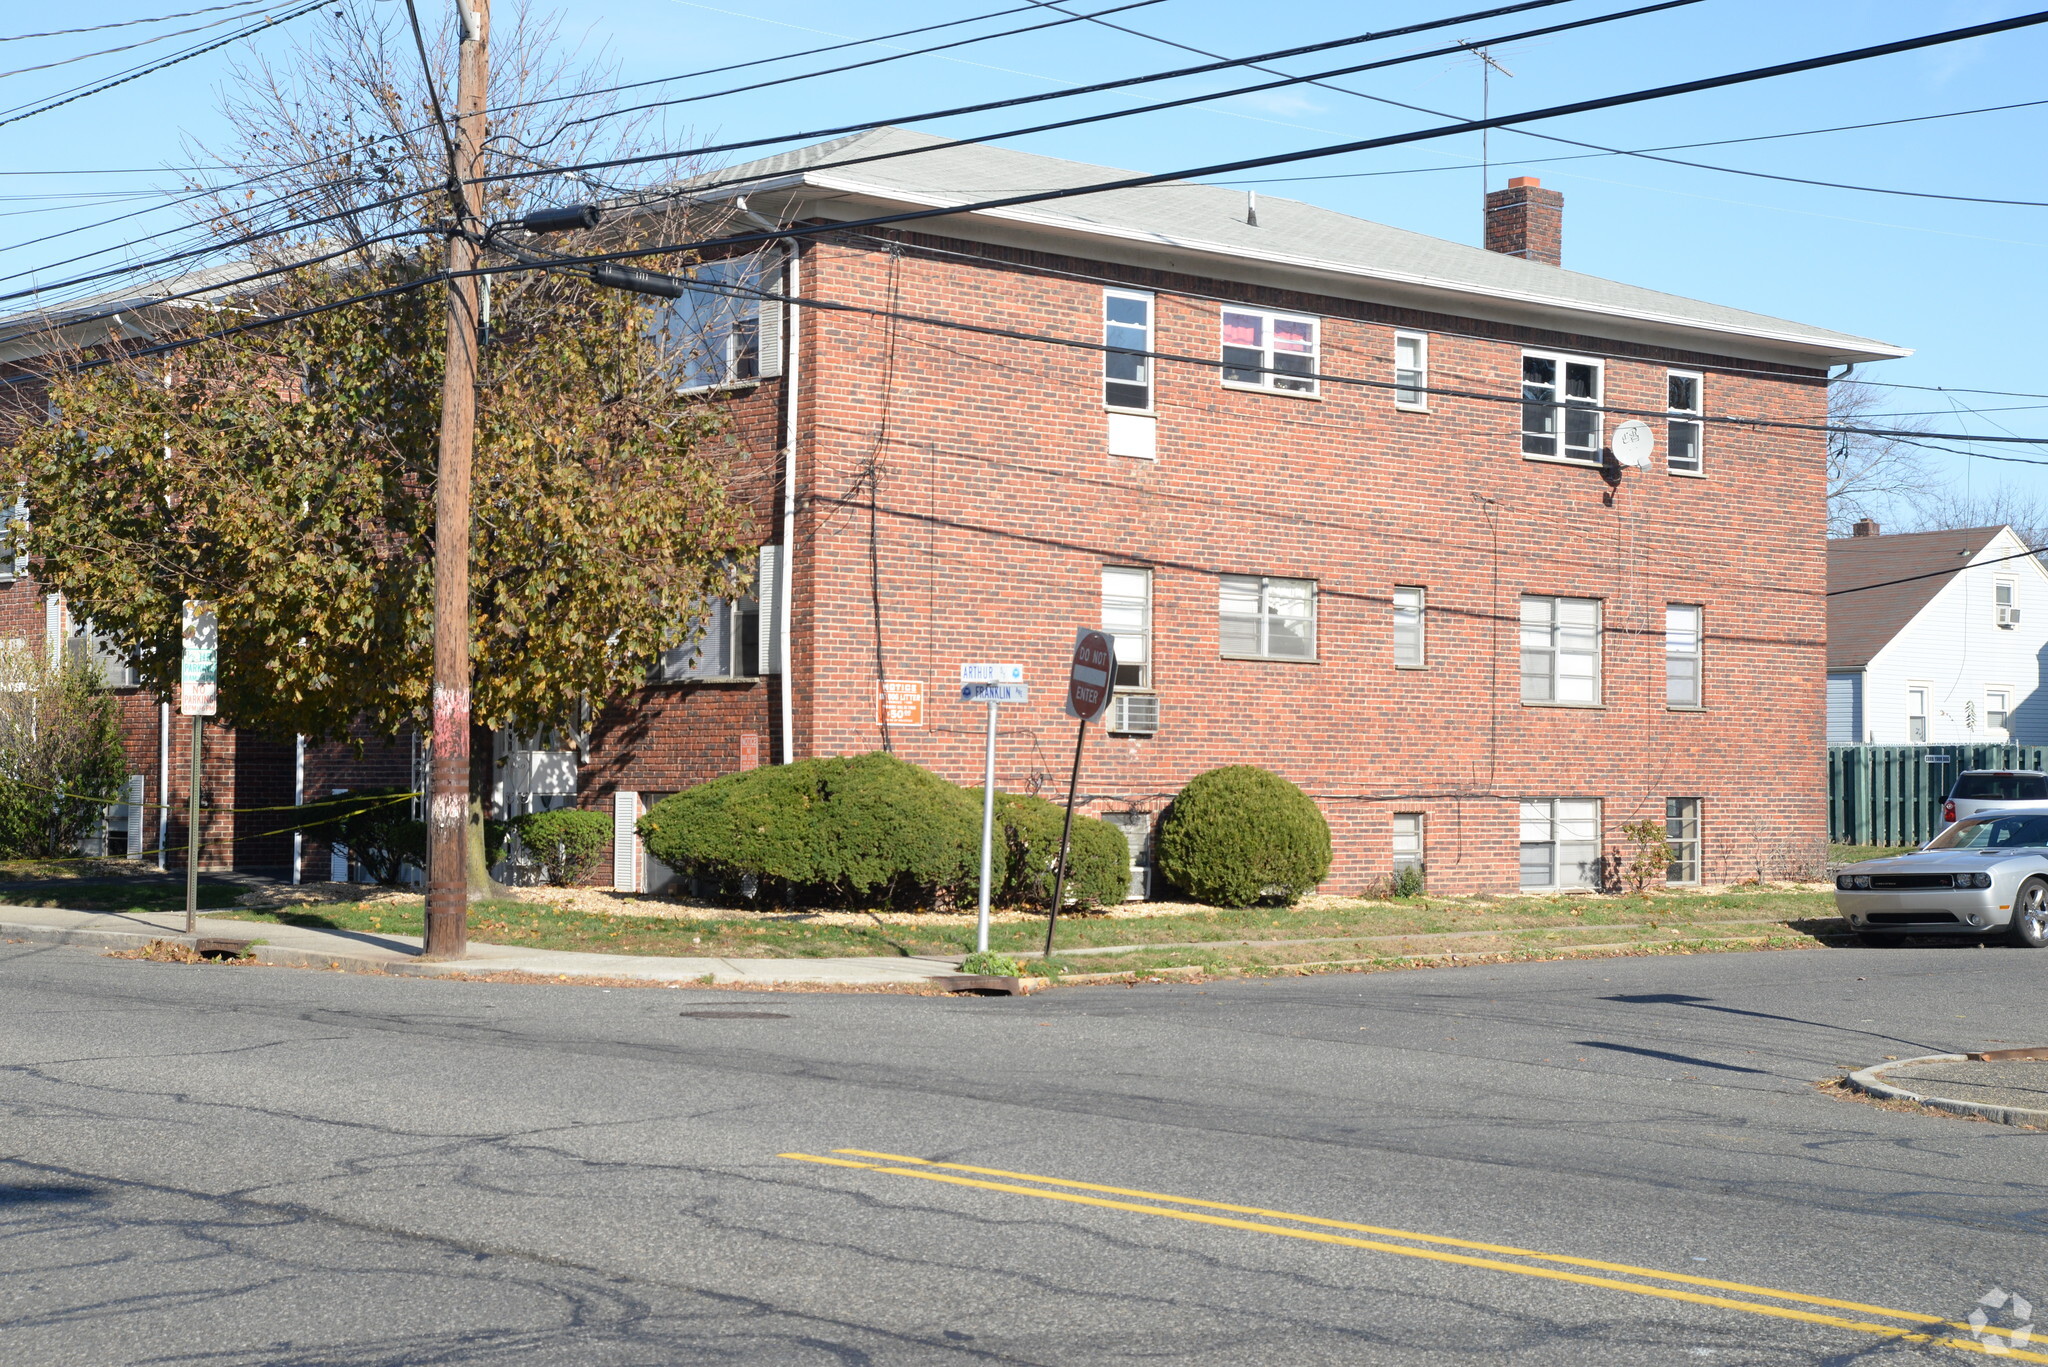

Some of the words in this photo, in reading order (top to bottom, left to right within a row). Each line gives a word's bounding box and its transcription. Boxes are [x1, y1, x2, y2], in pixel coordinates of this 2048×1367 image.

[199, 653, 211, 662] HR
[1080, 647, 1090, 661] DO
[1092, 650, 1107, 666] NOT
[963, 666, 993, 679] ARTHUR
[193, 686, 205, 695] NO
[975, 686, 1011, 699] FRANKLIN
[1076, 686, 1099, 704] ENTER
[184, 695, 214, 704] PARKING
[899, 694, 921, 702] LITTER
